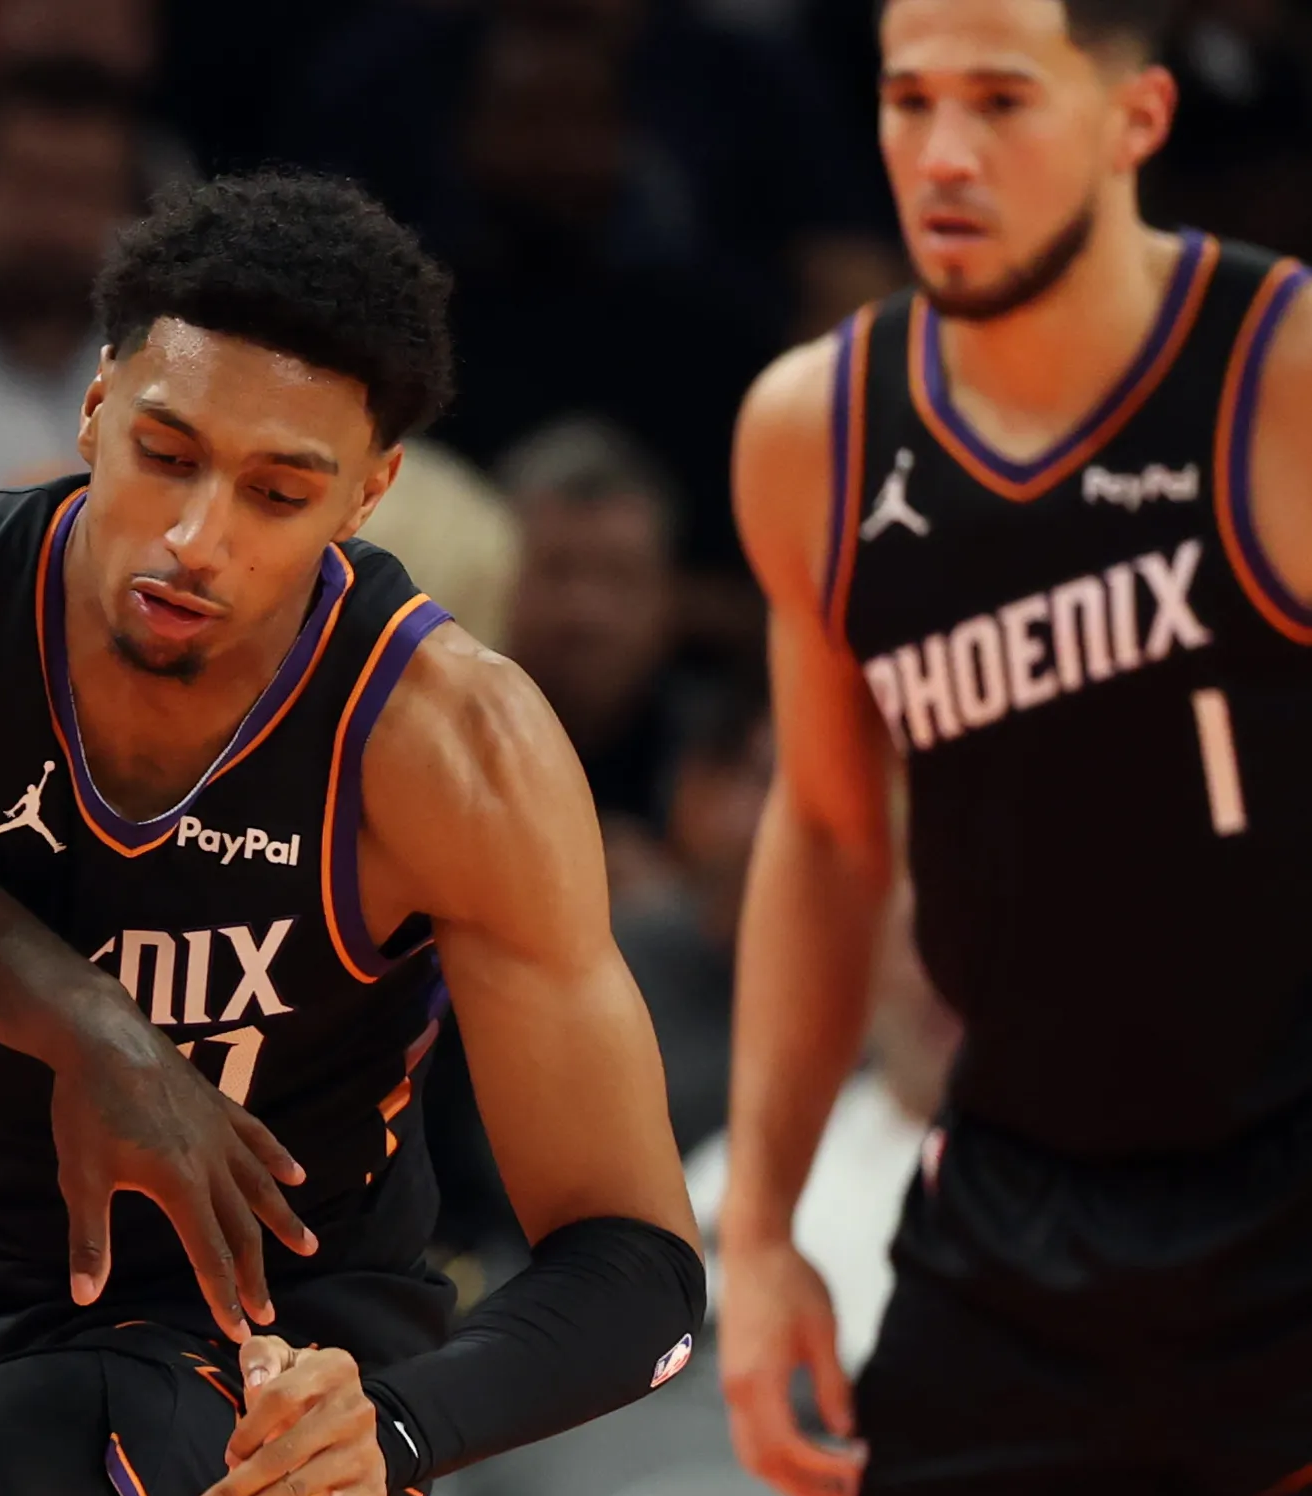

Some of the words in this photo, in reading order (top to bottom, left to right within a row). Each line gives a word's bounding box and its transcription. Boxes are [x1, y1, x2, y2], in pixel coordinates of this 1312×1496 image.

[862, 538, 1213, 756] PHOENIX
[1192, 687, 1247, 837] 1
[177, 815, 301, 867] PayPal
